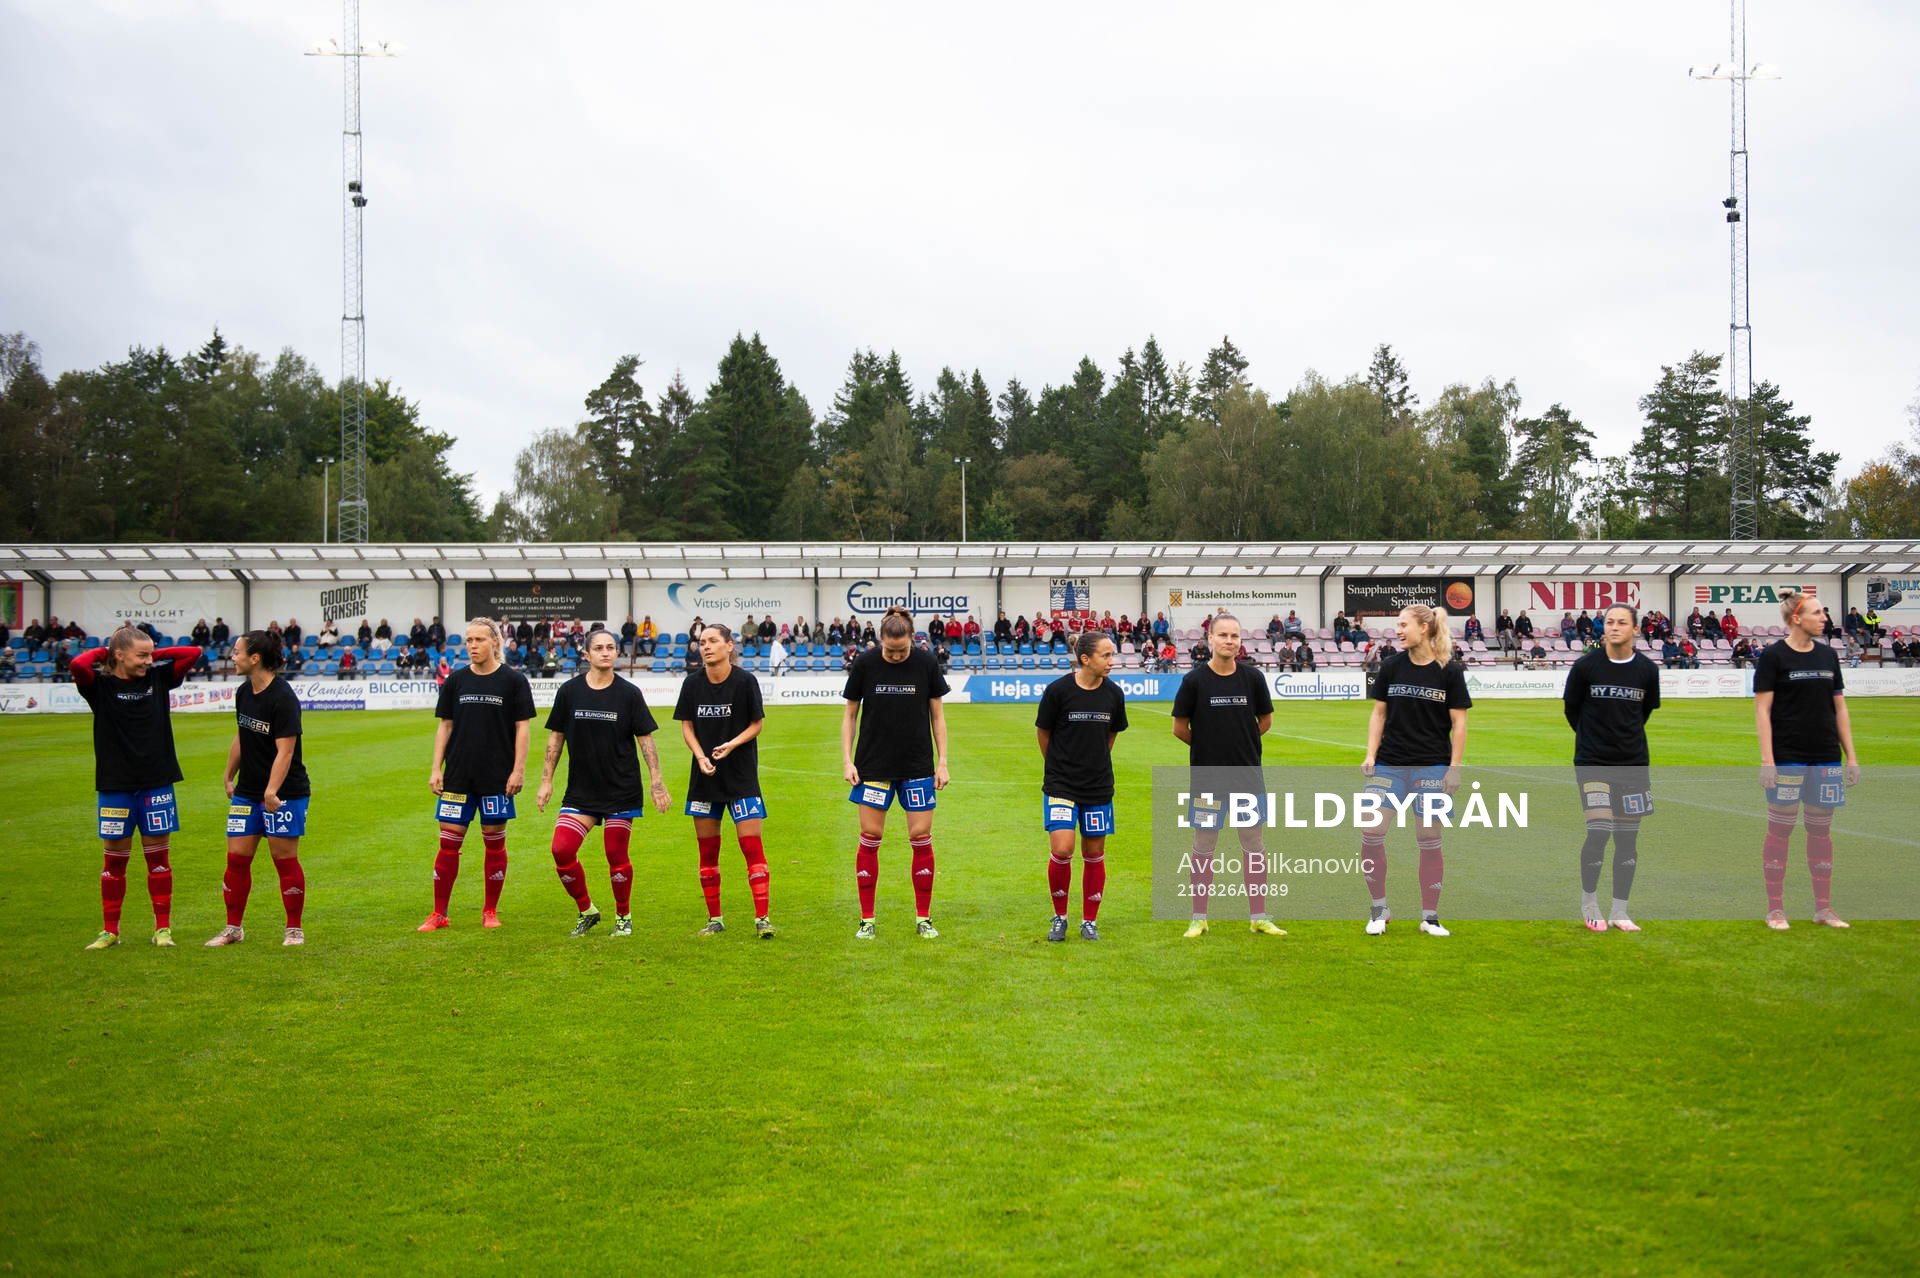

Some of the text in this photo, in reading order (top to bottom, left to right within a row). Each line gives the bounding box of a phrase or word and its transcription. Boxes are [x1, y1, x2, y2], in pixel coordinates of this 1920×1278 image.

[320, 583, 369, 607] GOODBYE
[1186, 590, 1297, 599] Hässleholms kommun
[1347, 585, 1437, 596] Snapphanebygdens
[1528, 581, 1641, 610] NIBE
[490, 596, 582, 604] exaktacreative
[694, 597, 781, 611] Vittsjö Sjukhem
[846, 581, 968, 619] Emmaljunga
[1391, 597, 1437, 607] Sparbank
[116, 610, 185, 618] SUNLIGHT
[323, 600, 367, 622] KANSAS
[307, 681, 364, 698] Camping
[369, 682, 438, 694] BILCENTR
[991, 681, 1033, 699] Heja
[1117, 679, 1160, 696] boll!
[1275, 674, 1361, 700] Emmaljunga
[781, 690, 845, 698] GRUNDFO
[584, 712, 618, 720] SUNDHAGE
[697, 705, 732, 717] MARTA
[276, 811, 293, 822] 20
